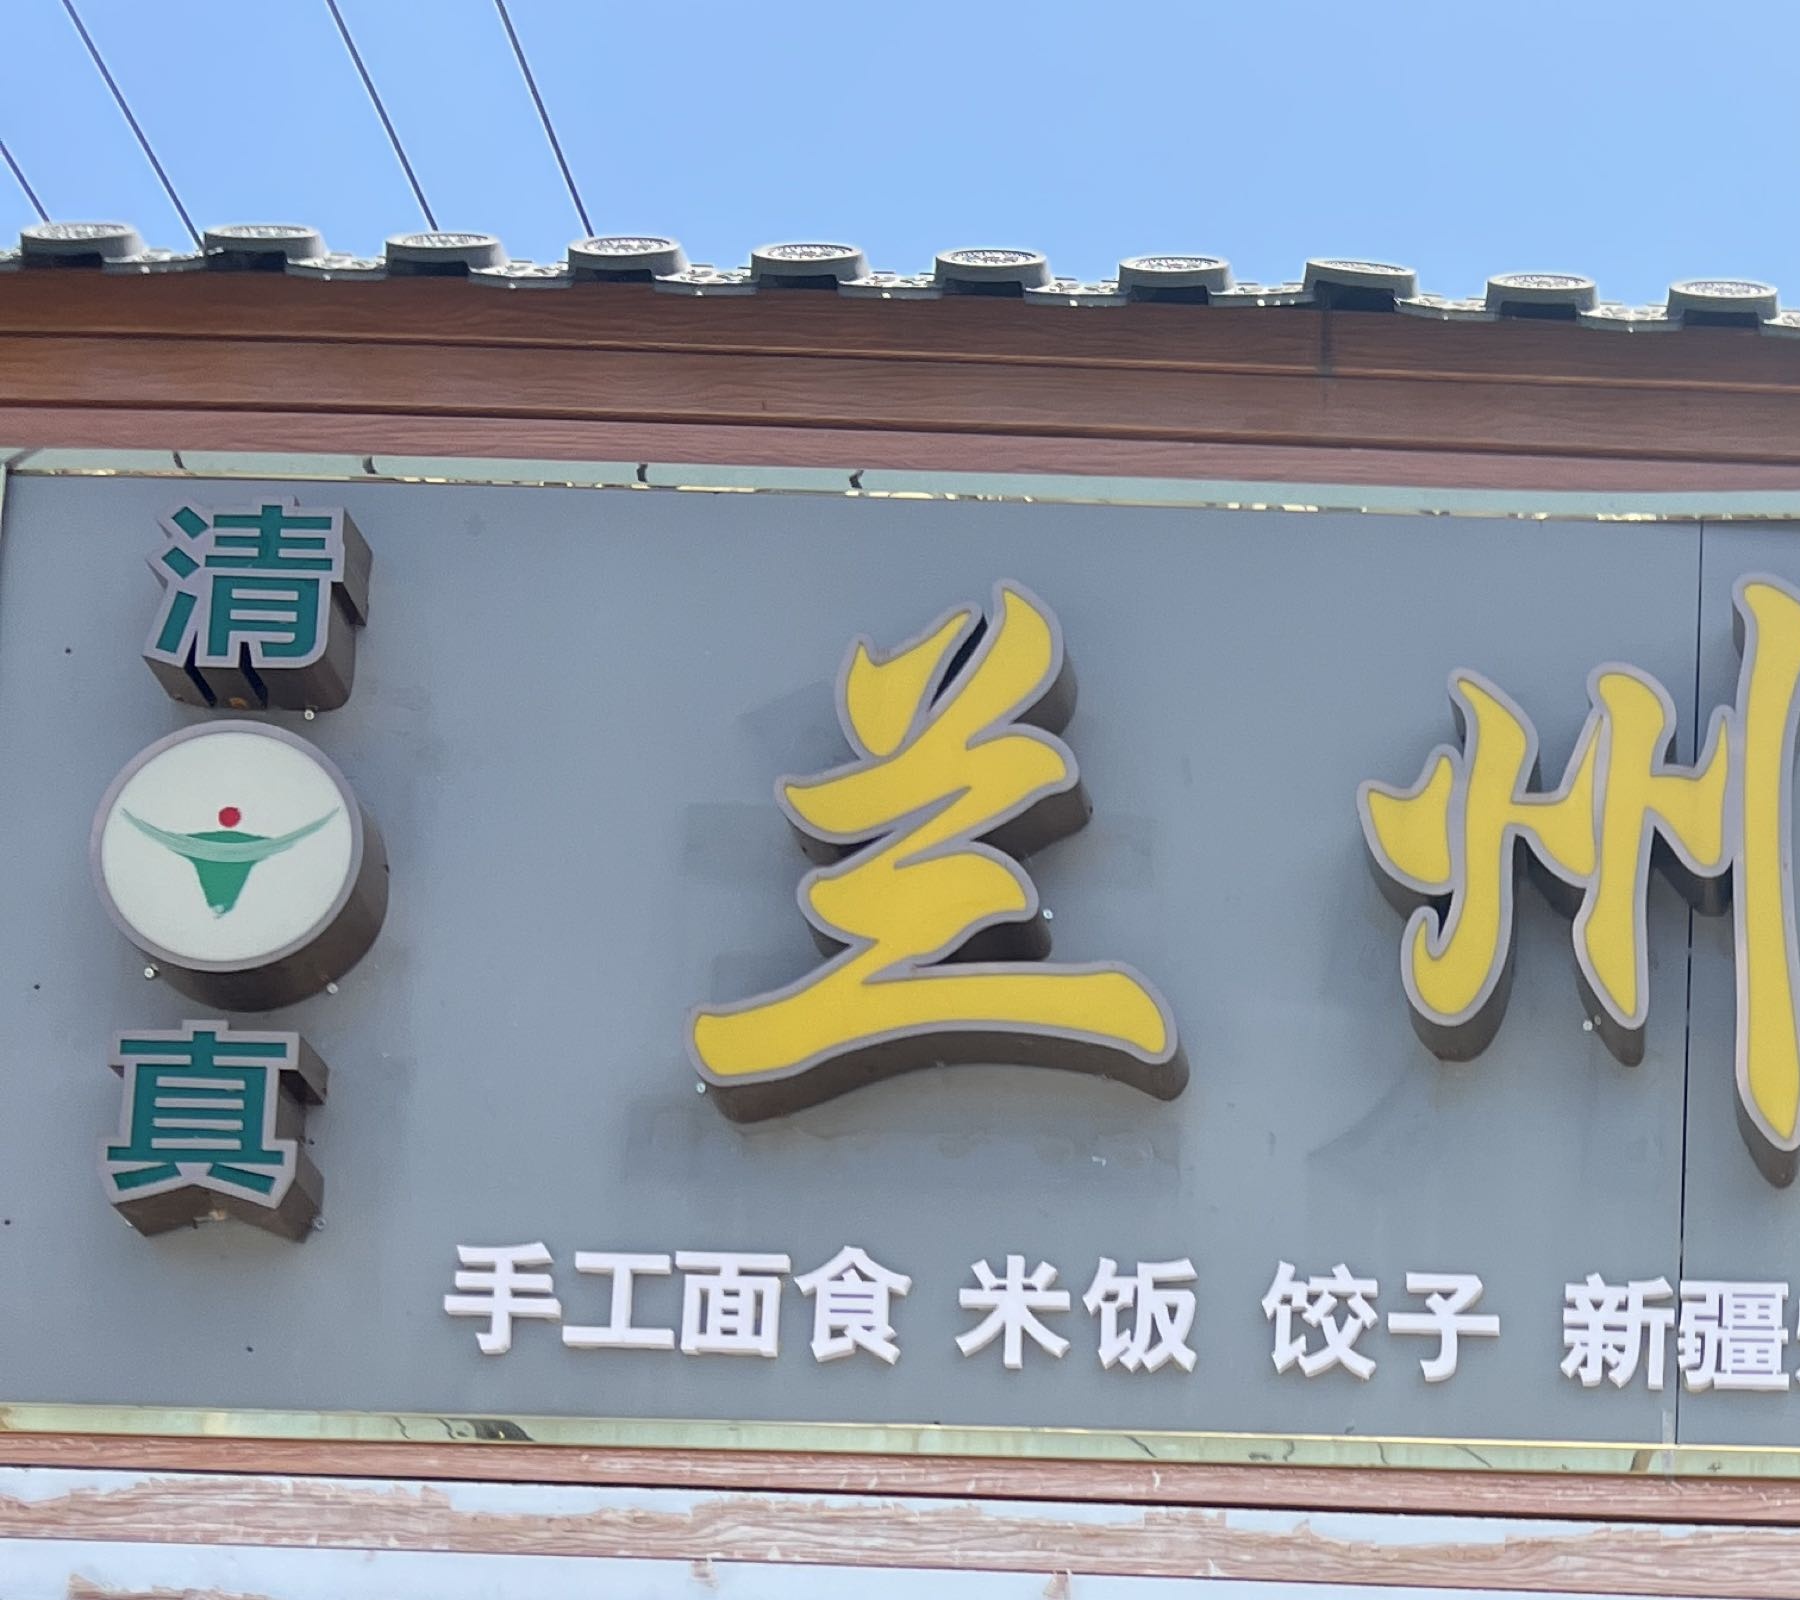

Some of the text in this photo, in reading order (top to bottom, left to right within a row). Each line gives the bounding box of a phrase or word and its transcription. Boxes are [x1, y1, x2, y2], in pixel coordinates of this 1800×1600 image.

[443, 1243, 912, 1368] 手工面食
[957, 1253, 1199, 1376] 米饭
[1261, 1259, 1500, 1385] 饺子
